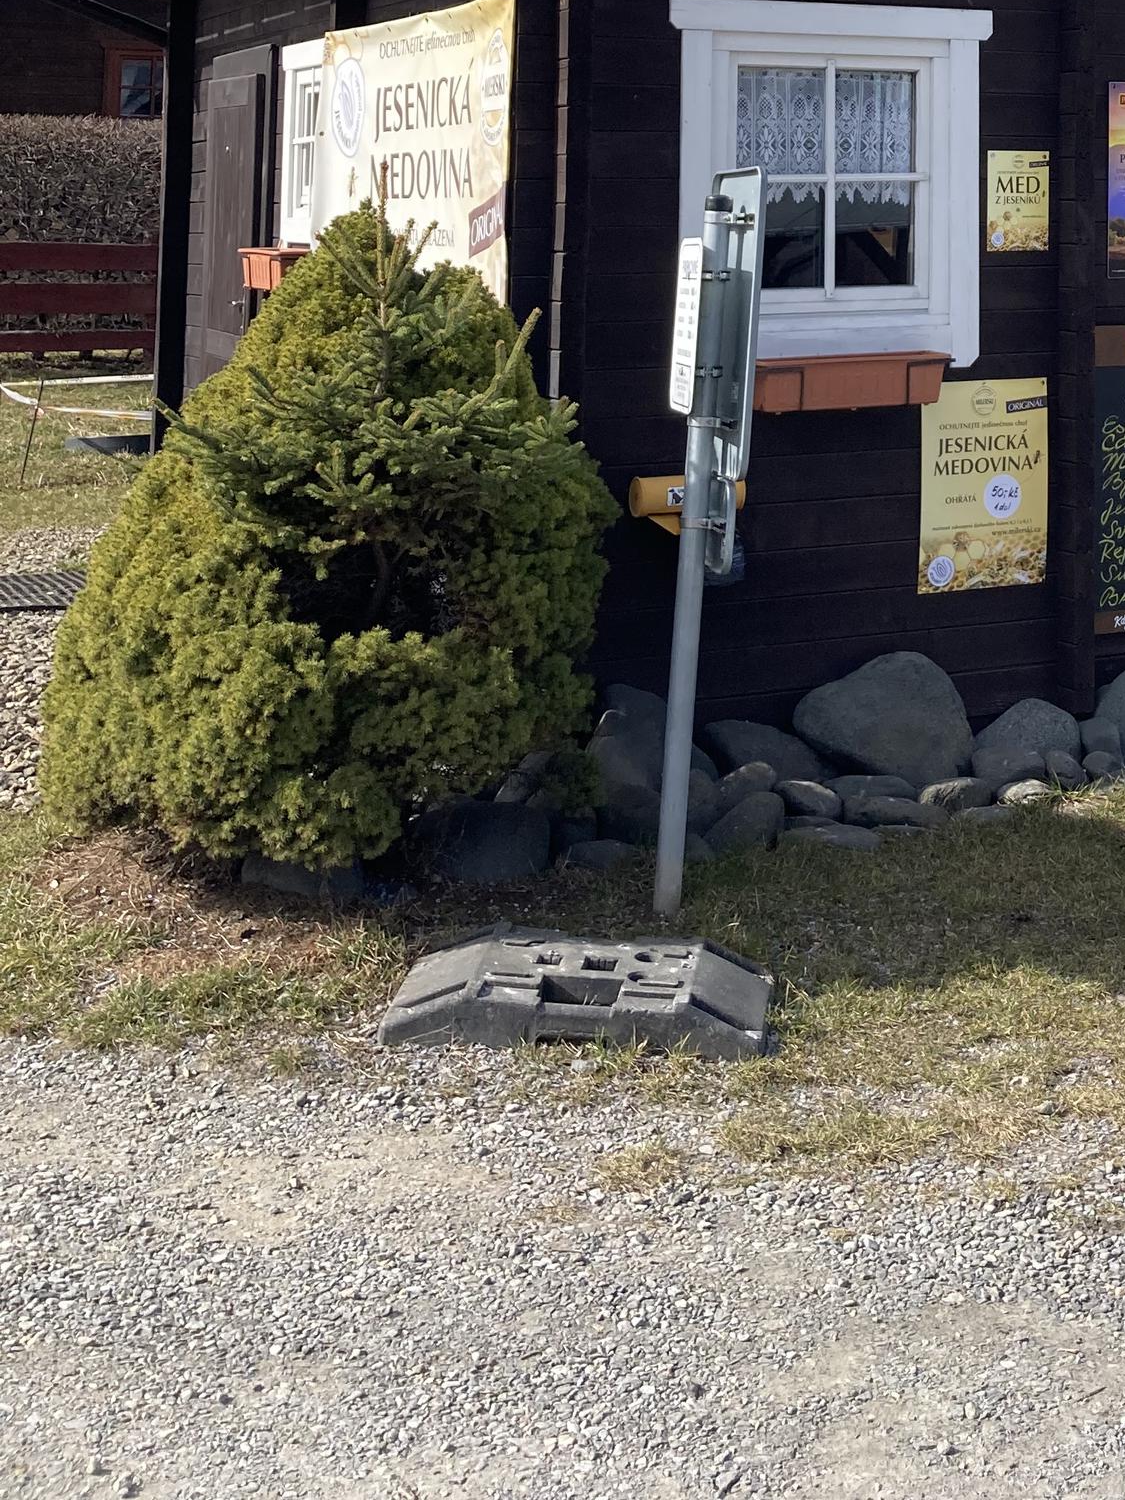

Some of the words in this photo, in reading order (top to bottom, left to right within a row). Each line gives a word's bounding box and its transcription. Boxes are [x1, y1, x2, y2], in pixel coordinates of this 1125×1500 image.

[379, 35, 424, 59] OCHUTNEJTE
[374, 57, 473, 143] JESENICKÁ
[370, 147, 474, 200] MEDOVINA
[995, 176, 1041, 194] MED
[995, 196, 1002, 204] Z
[1007, 397, 1044, 412] ORIGINÁL
[939, 422, 980, 431] OCHUTNEJTE
[938, 429, 1028, 457] JESENICKÁ
[934, 455, 1033, 476] MEDOVINA
